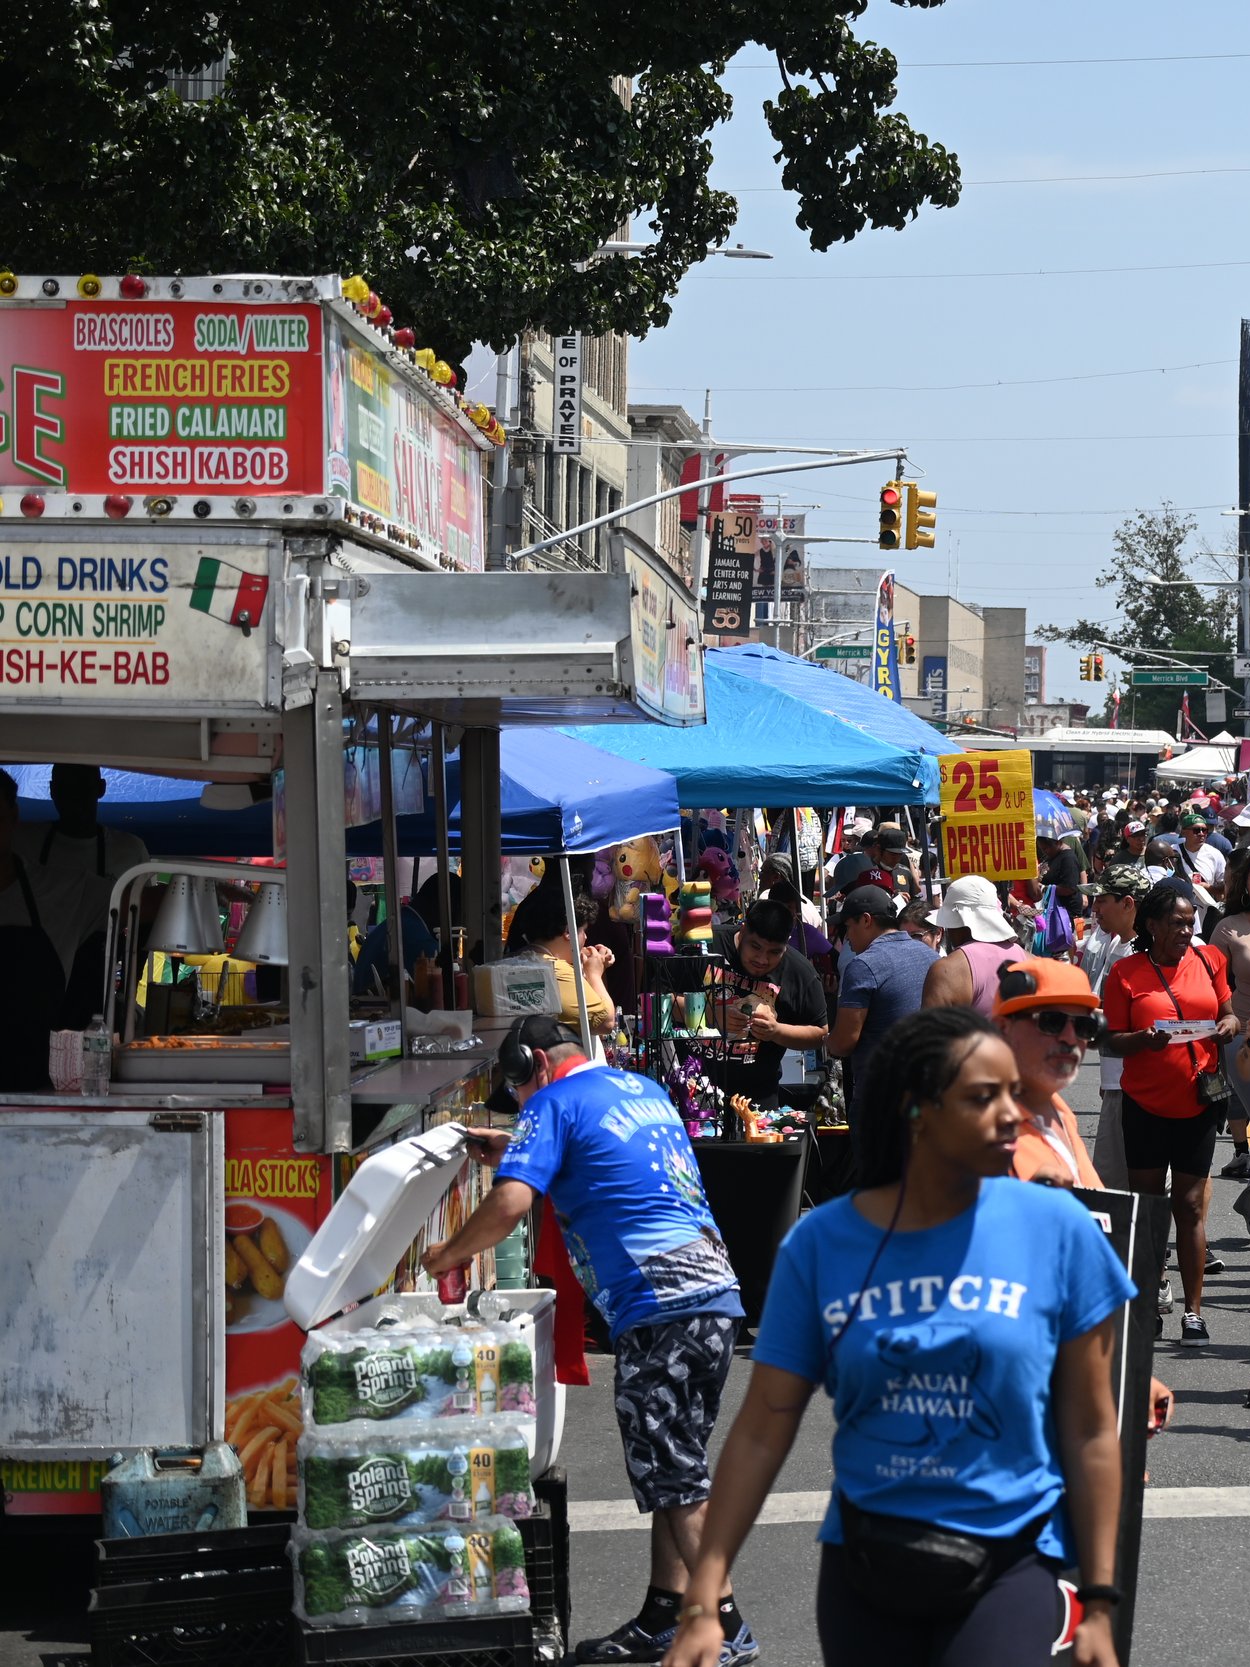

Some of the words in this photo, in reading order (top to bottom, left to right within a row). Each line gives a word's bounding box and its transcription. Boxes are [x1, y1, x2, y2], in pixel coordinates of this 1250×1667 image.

[75, 316, 173, 348] BRASCIOLES
[196, 316, 308, 352] SODA/WATER
[559, 356, 577, 367] OF
[108, 362, 206, 393] FRENCH
[216, 363, 287, 394] FRIES
[111, 407, 170, 437] FRIED
[177, 407, 285, 438] CALAMARI
[559, 375, 576, 447] PRAYER
[0, 364, 65, 486] E
[112, 450, 188, 481] SHISH
[198, 450, 286, 481] KABOB
[734, 516, 752, 537] 50
[756, 519, 796, 529] OOKE'S
[0, 556, 42, 590] LD
[58, 557, 168, 593] DRINKS
[714, 558, 740, 568] JAMAICA
[714, 569, 735, 579] CENTER
[737, 570, 749, 580] FOR
[712, 592, 742, 601] LEARNING
[713, 580, 728, 589] ARTS
[729, 581, 742, 590] AND
[16, 601, 84, 638] CORN
[93, 603, 165, 638] SHRIMP
[712, 608, 740, 629] 50
[862, 648, 874, 656] Blv
[1152, 674, 1175, 682] Merrick
[1175, 674, 1188, 682] Blvd
[1005, 794, 1012, 808] &
[1014, 792, 1026, 808] UP
[946, 822, 1027, 875] PERFUME
[225, 1164, 252, 1192] LA
[258, 1164, 318, 1193] STICKS
[823, 1274, 1028, 1328] STITCH
[354, 1352, 415, 1380] Poland
[477, 1350, 496, 1361] 40
[357, 1369, 417, 1400] Spring
[887, 1373, 969, 1394] KAUAI
[882, 1393, 974, 1419] HAWAII
[473, 1453, 491, 1468] 40
[347, 1461, 408, 1490] Poland
[145, 1498, 189, 1509] POTABLE
[352, 1478, 411, 1510] Spring
[144, 1516, 191, 1530] WATER
[468, 1535, 489, 1548] 40
[350, 1555, 411, 1588] Spring
